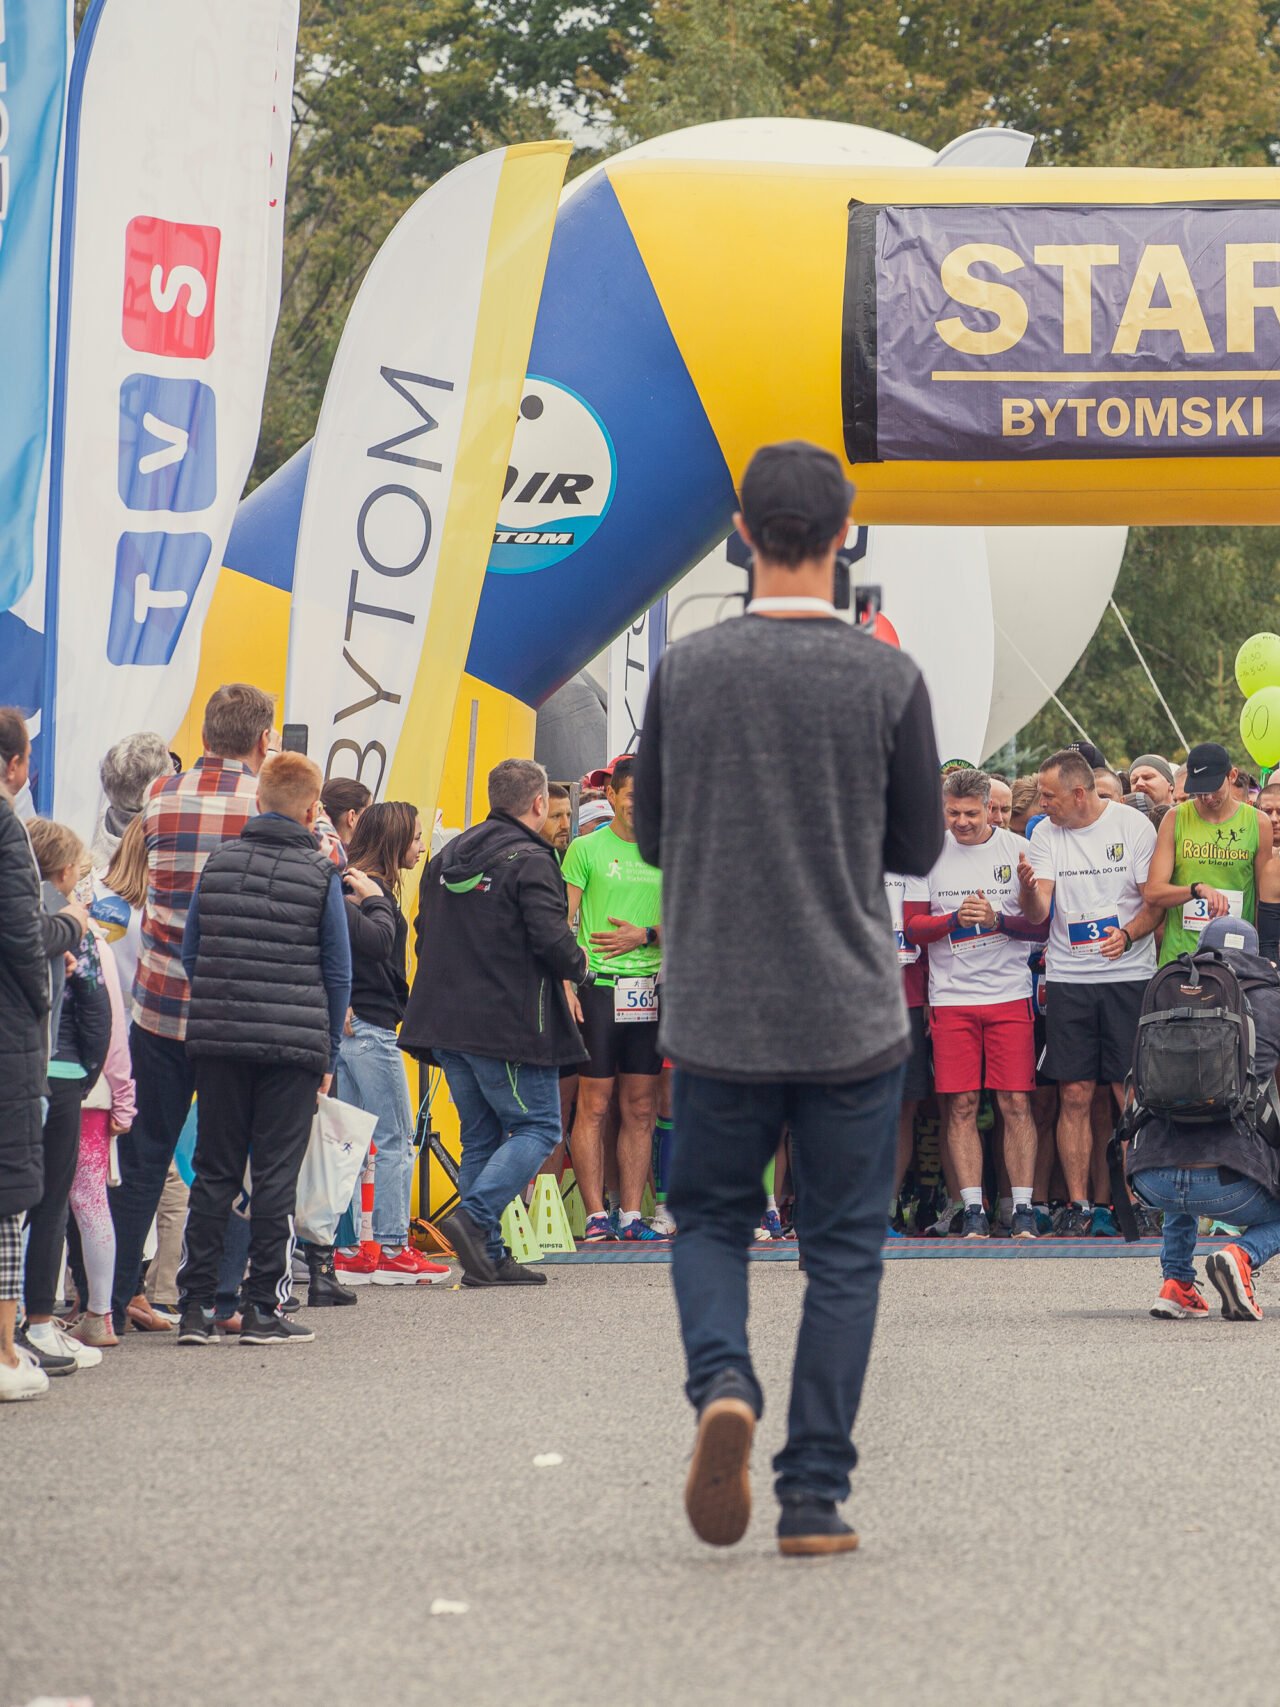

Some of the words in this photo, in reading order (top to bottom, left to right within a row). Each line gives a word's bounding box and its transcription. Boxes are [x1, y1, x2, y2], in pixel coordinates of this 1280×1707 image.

[1001, 394, 1264, 439] BYTOMSKI
[494, 531, 574, 545] TOM
[1058, 869, 1077, 878] BYTOM
[1079, 867, 1101, 876] WRACA
[1103, 867, 1113, 875] DO
[1115, 866, 1128, 874] GRY
[999, 888, 1012, 896] GRY
[1087, 923, 1101, 940] 3
[898, 932, 906, 949] 2
[627, 990, 655, 1008] 565
